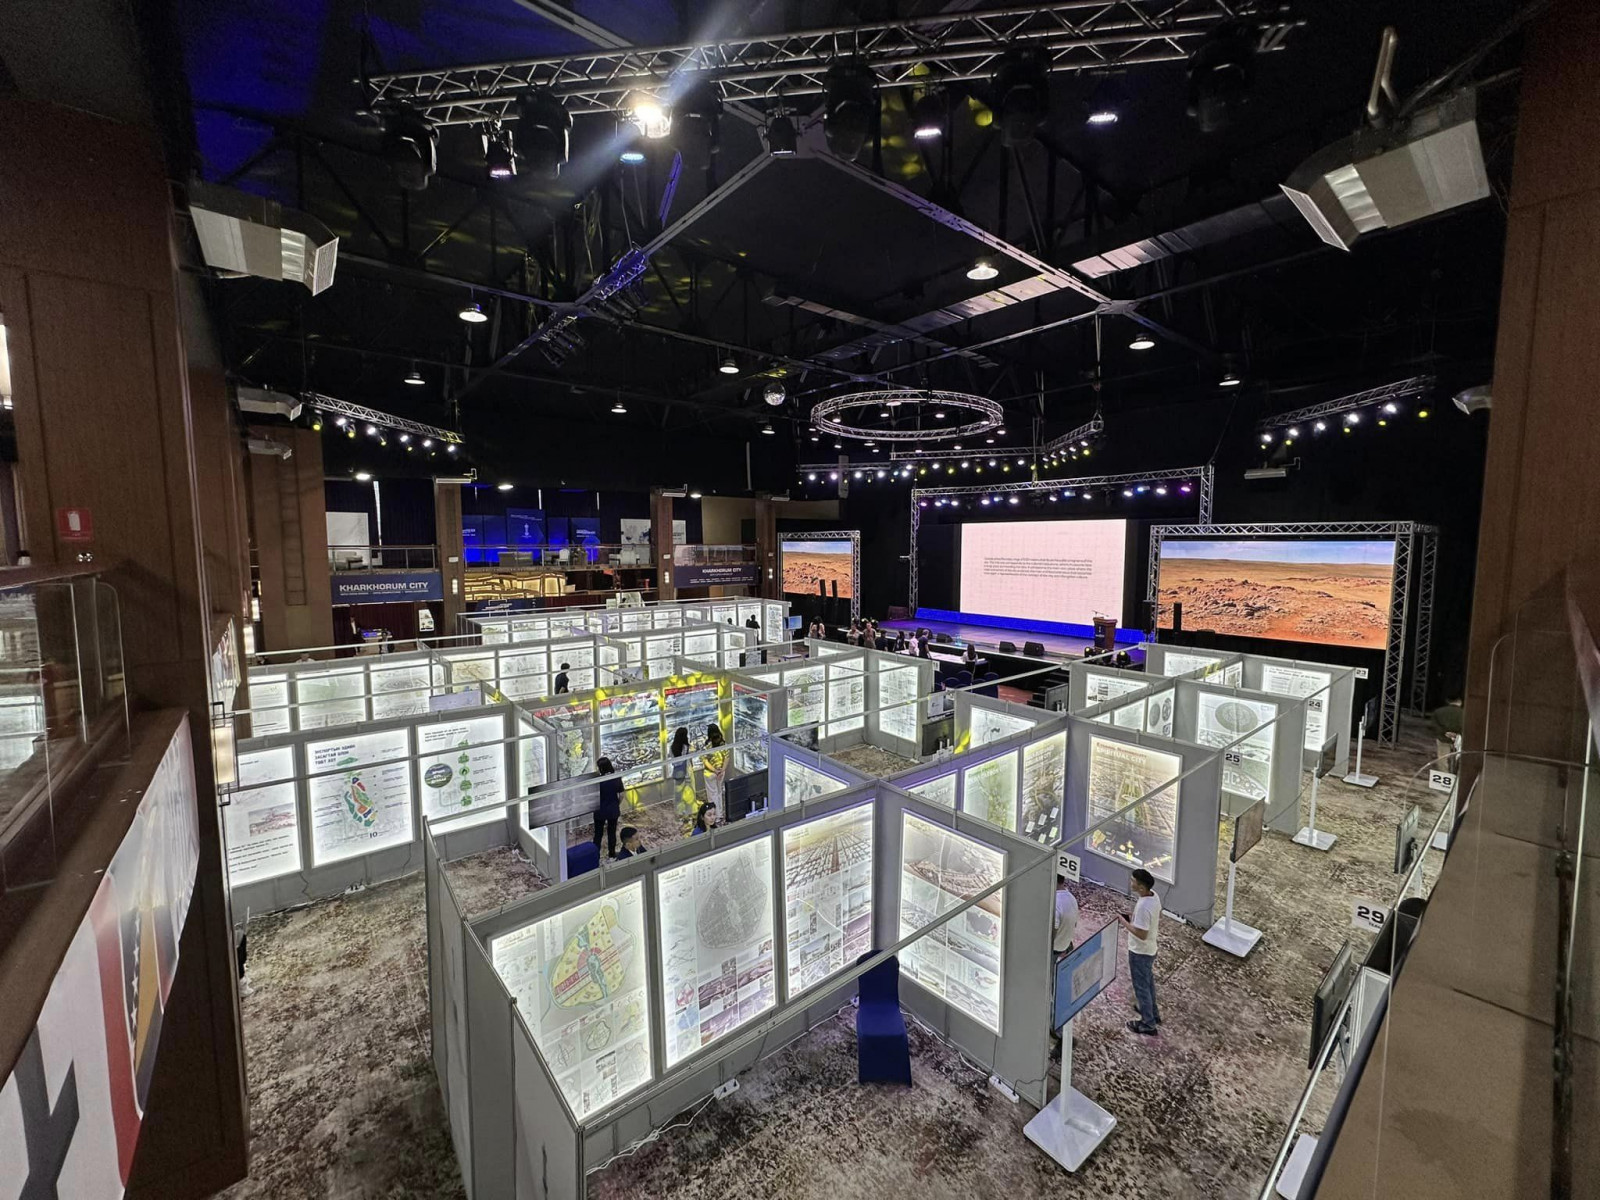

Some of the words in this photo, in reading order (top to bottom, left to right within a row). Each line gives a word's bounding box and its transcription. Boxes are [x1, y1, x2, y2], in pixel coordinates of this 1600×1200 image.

[339, 582, 407, 592] KHARKHORUM
[409, 581, 429, 590] CITY
[1225, 753, 1240, 763] 25
[1433, 774, 1452, 786] 28
[1060, 856, 1078, 872] 26
[1357, 905, 1385, 924] 29
